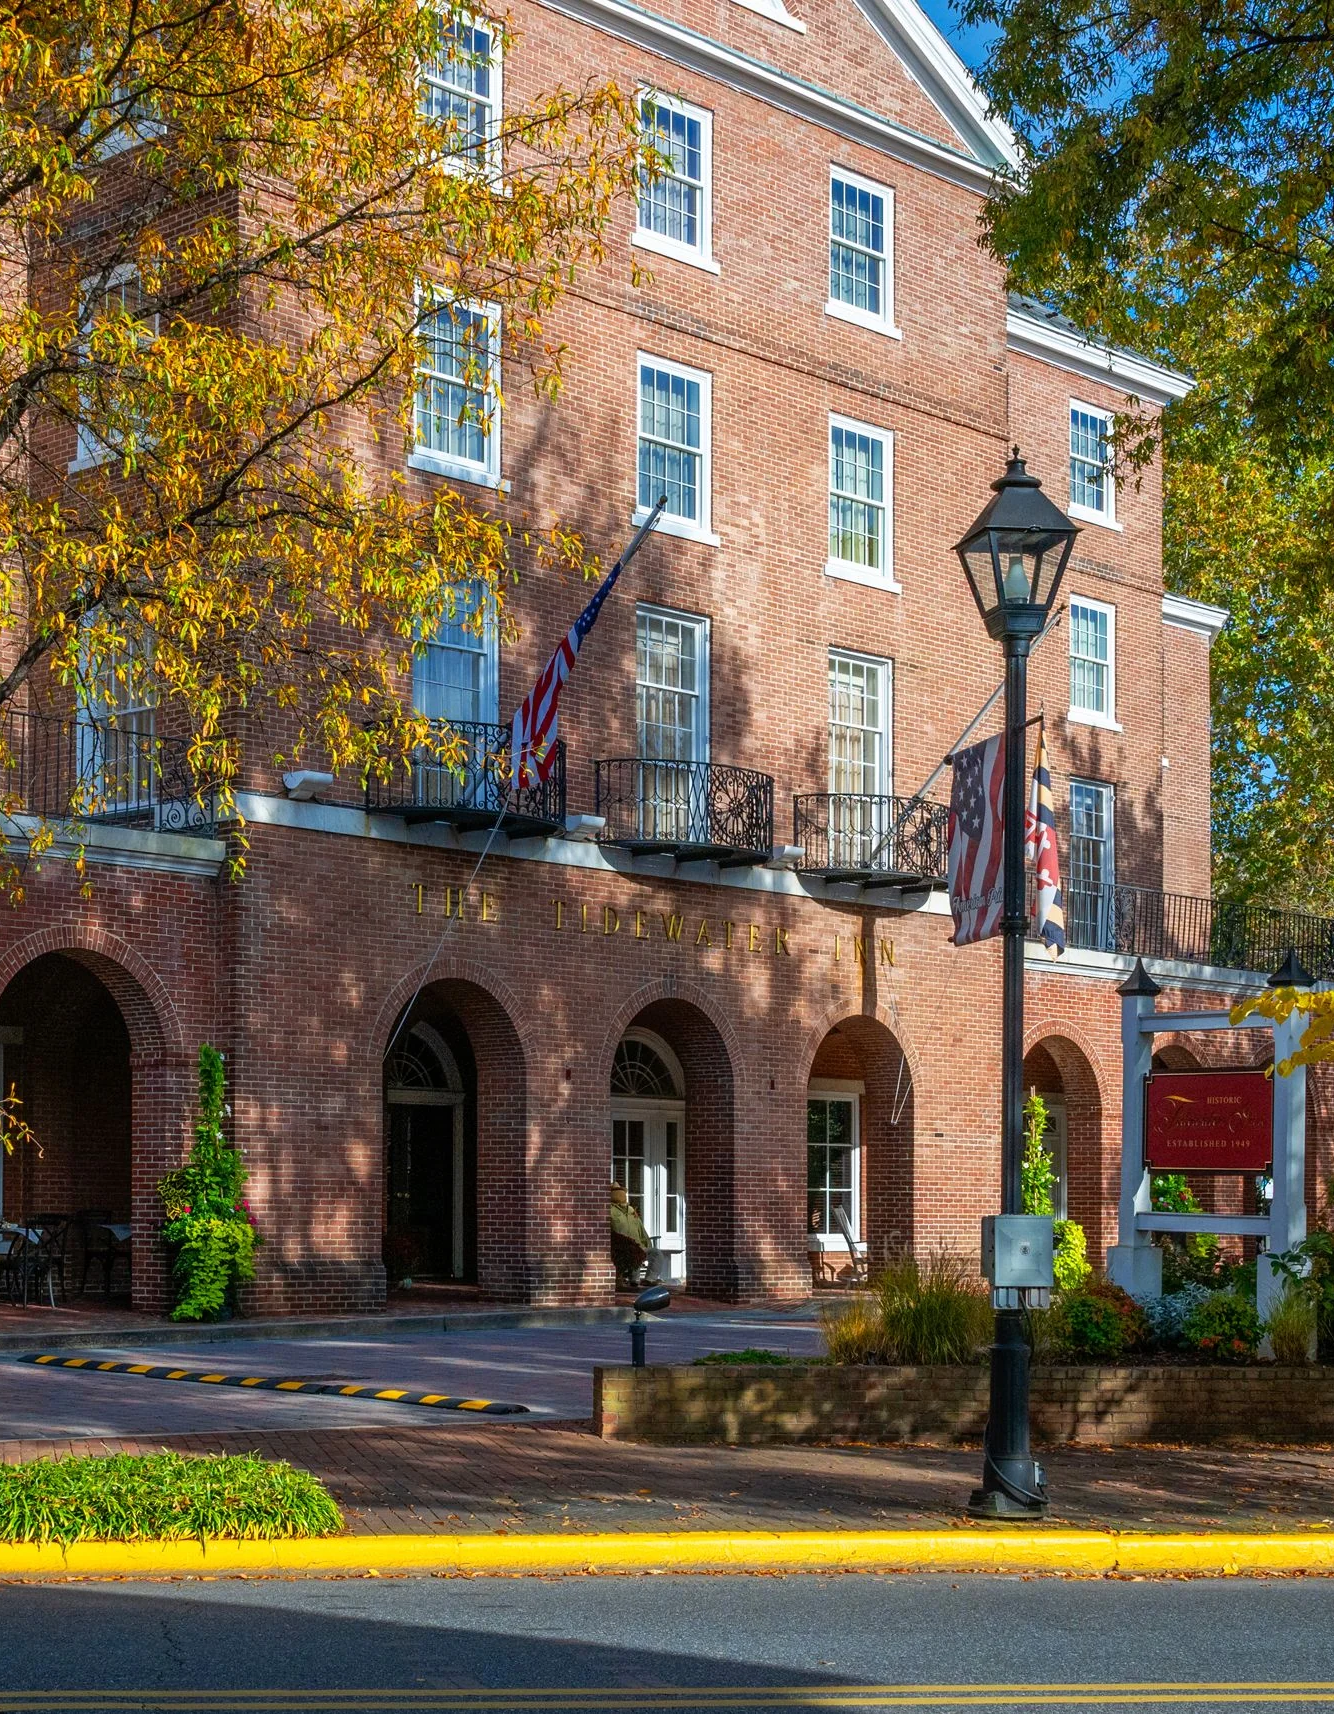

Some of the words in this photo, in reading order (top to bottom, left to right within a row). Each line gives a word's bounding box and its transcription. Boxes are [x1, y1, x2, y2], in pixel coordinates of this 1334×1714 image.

[953, 893, 986, 914] American
[413, 884, 499, 922] THE
[550, 899, 790, 956] TIDEWATER
[835, 934, 895, 967] INN
[1207, 1097, 1242, 1105] HISTORIC
[1167, 1139, 1227, 1149] ESTABLISHED
[1231, 1139, 1250, 1149] 1949
